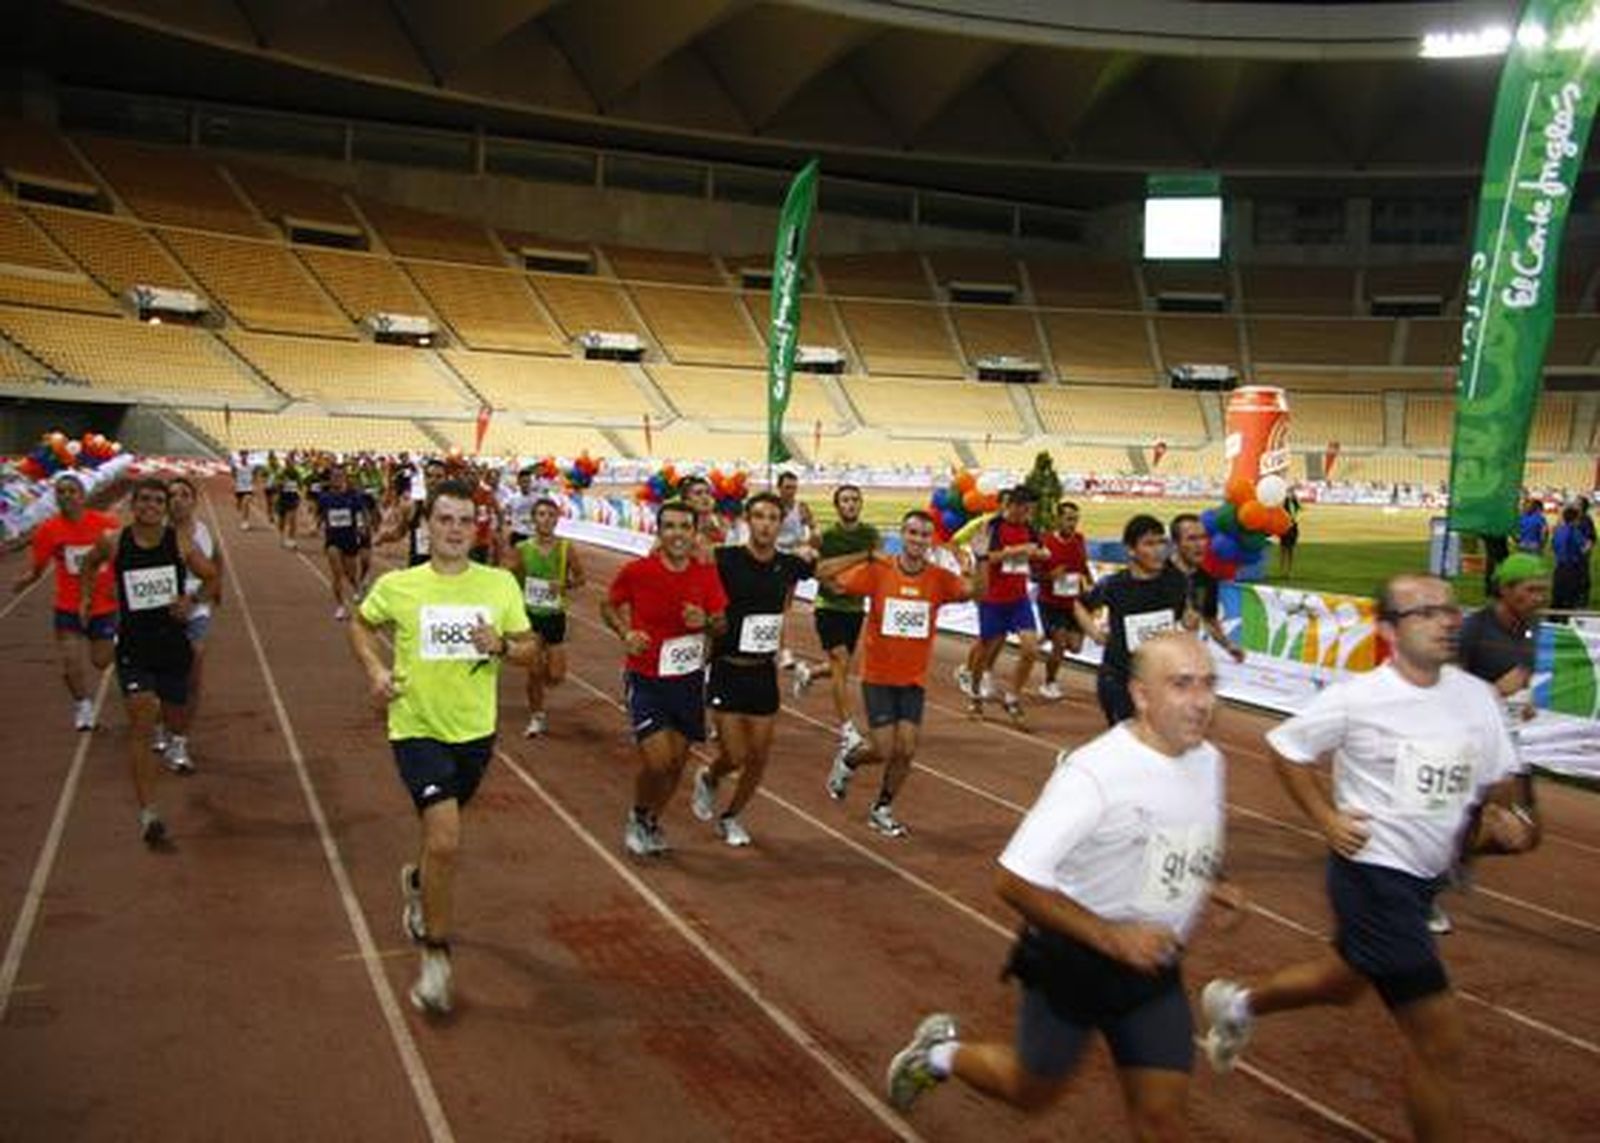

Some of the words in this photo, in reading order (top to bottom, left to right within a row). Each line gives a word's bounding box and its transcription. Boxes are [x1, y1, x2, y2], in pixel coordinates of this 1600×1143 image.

[1511, 199, 1550, 278] Corte
[1502, 275, 1540, 307] El
[429, 622, 475, 645] 1683
